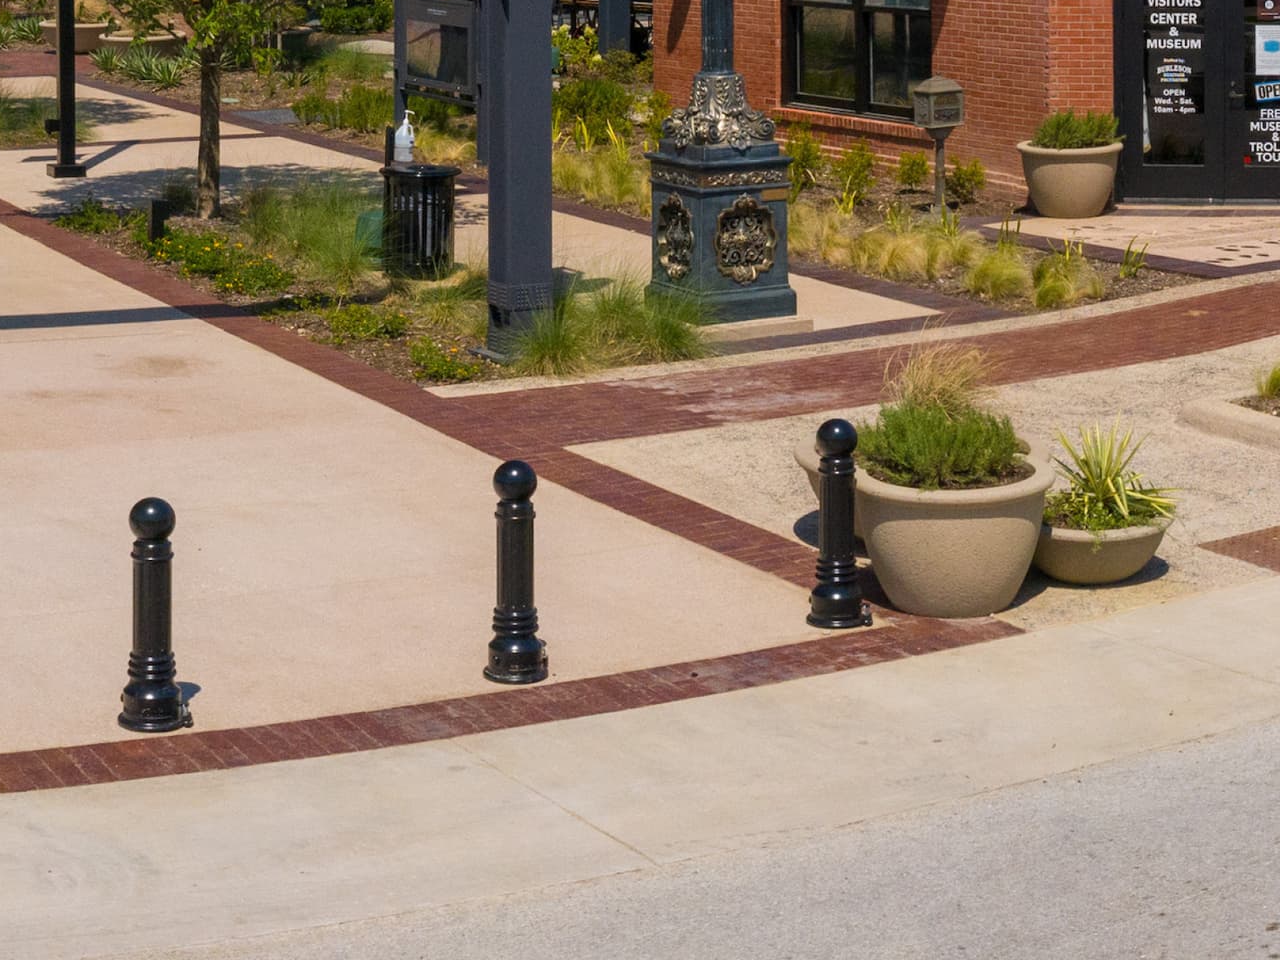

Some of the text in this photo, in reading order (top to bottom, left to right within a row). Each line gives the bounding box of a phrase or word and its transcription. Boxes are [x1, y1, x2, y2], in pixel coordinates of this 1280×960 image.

[1150, 12, 1198, 25] CENTER
[1169, 26, 1179, 37] &
[1146, 38, 1202, 49] MUSEUM
[1163, 88, 1186, 96] OPEN
[1179, 106, 1196, 114] 4pm
[1271, 132, 1280, 142] &
